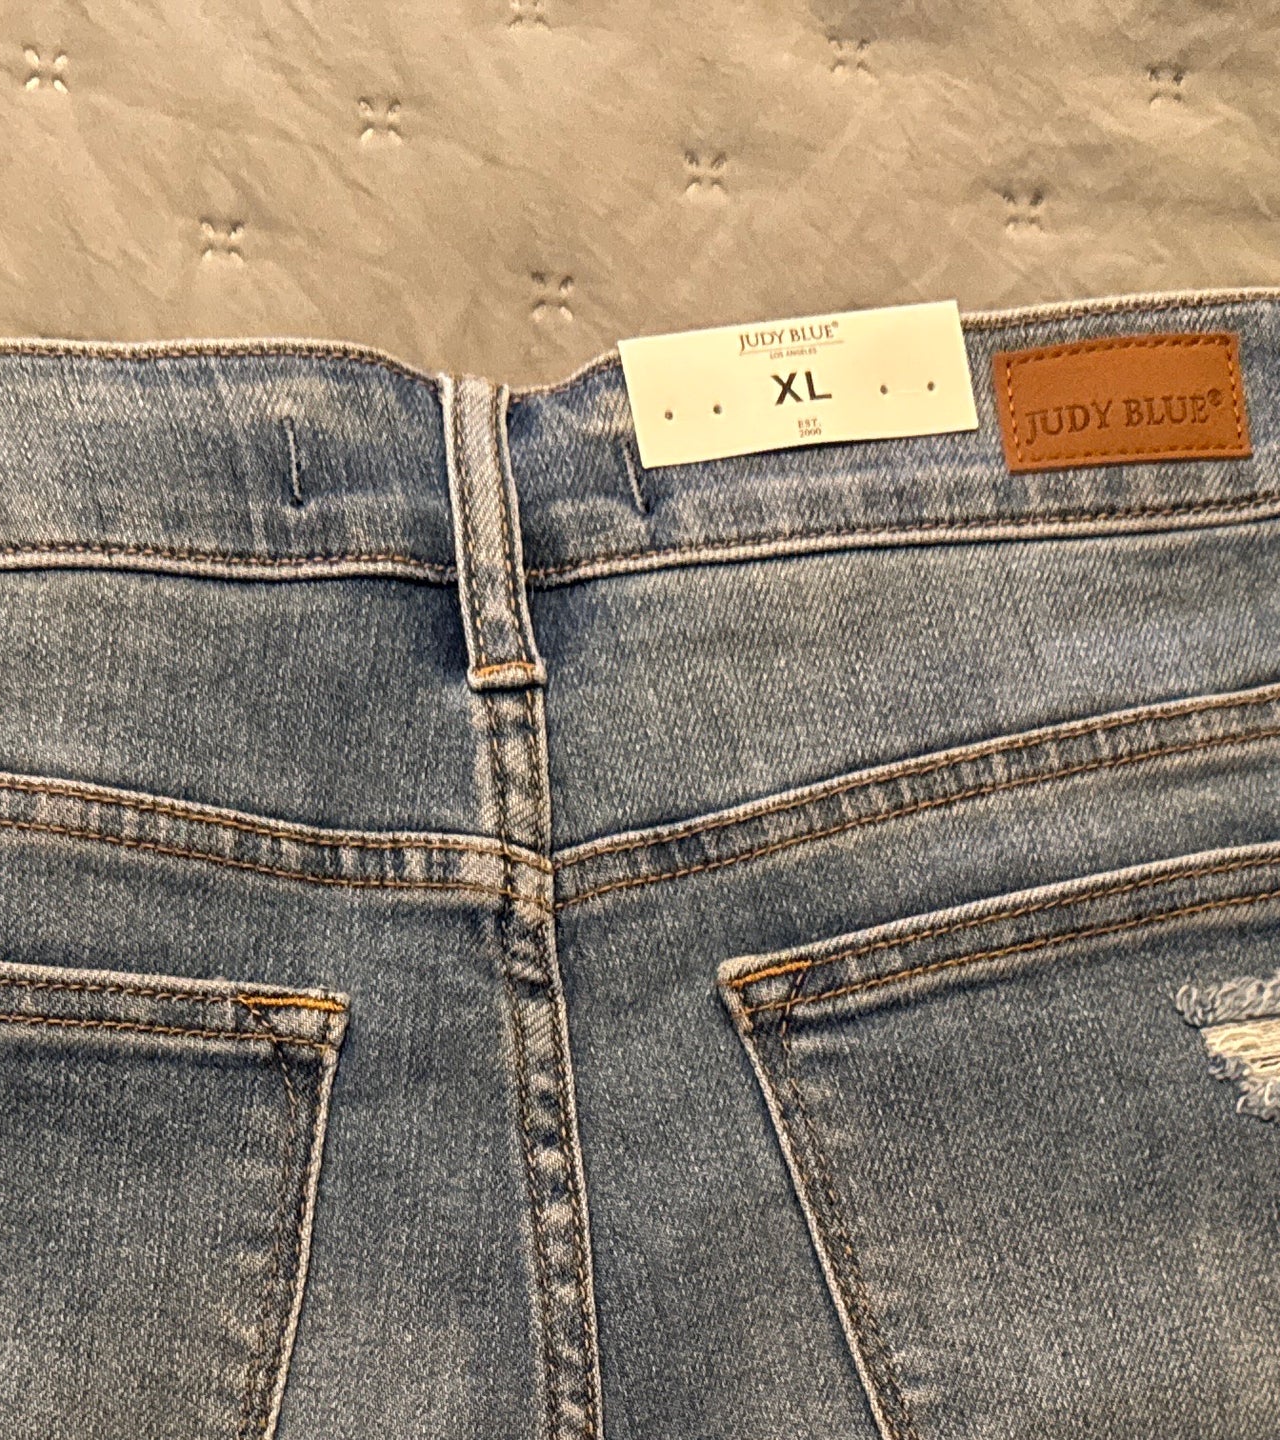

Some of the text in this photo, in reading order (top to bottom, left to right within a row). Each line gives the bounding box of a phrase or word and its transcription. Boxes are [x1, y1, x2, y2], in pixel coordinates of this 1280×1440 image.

[738, 329, 785, 352] JUDY
[770, 370, 833, 406] XL
[1025, 400, 1113, 445] JUDY
